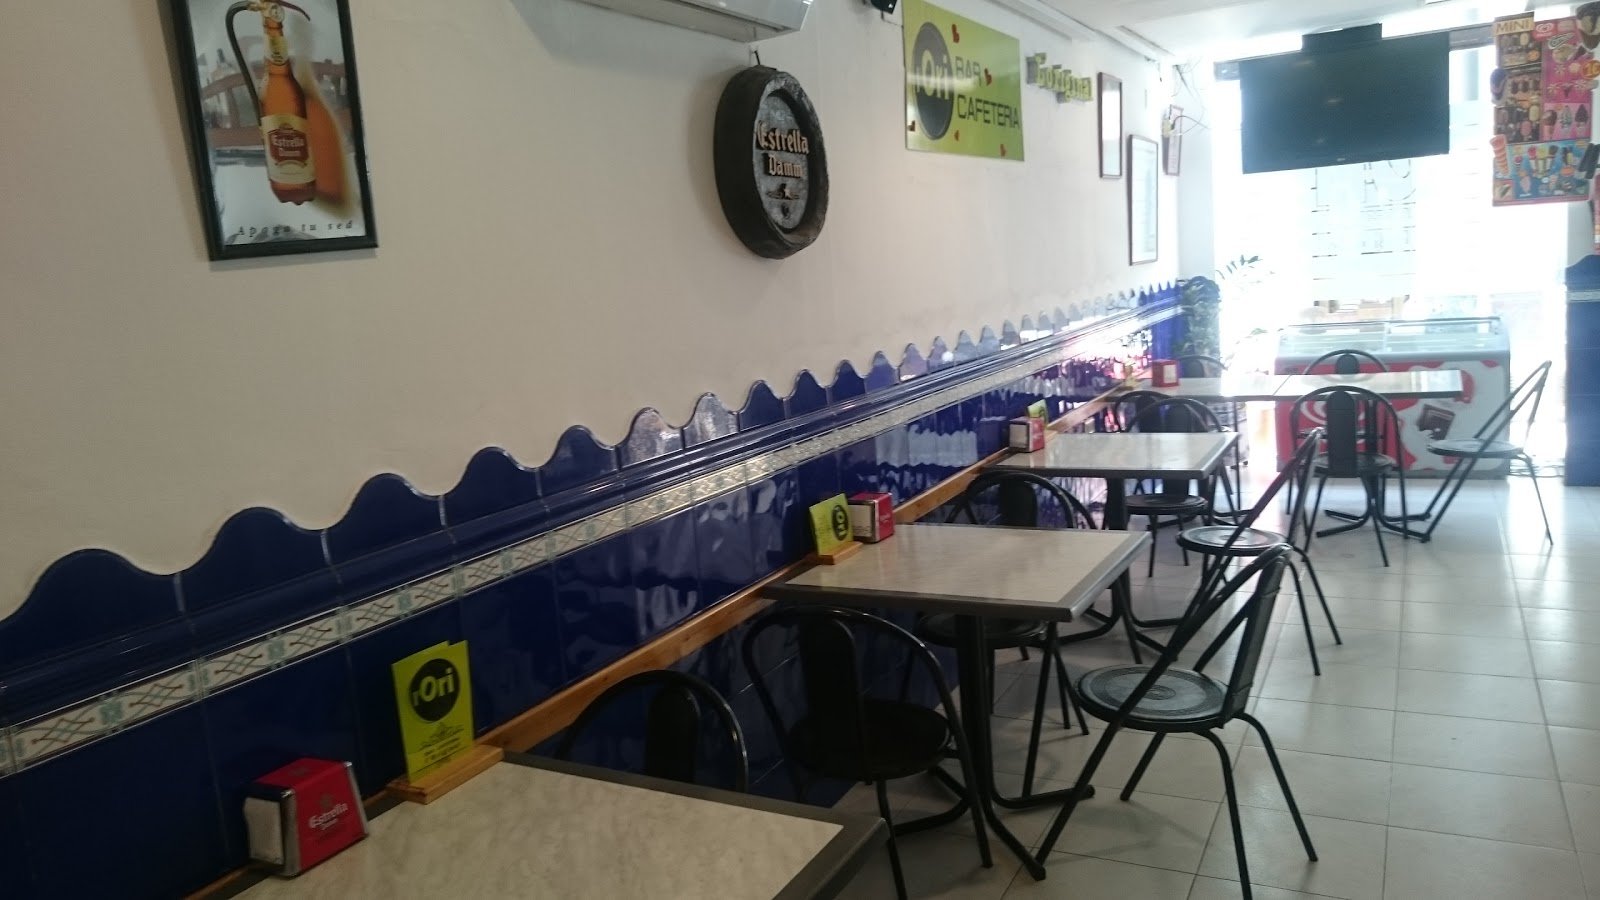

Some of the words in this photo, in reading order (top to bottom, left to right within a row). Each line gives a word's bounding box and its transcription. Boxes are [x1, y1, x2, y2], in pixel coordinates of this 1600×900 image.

[1495, 19, 1531, 34] MINI
[955, 56, 982, 87] BAR
[957, 94, 1020, 129] CAFETERIA
[756, 121, 809, 155] Estrella
[768, 154, 803, 178] Damm
